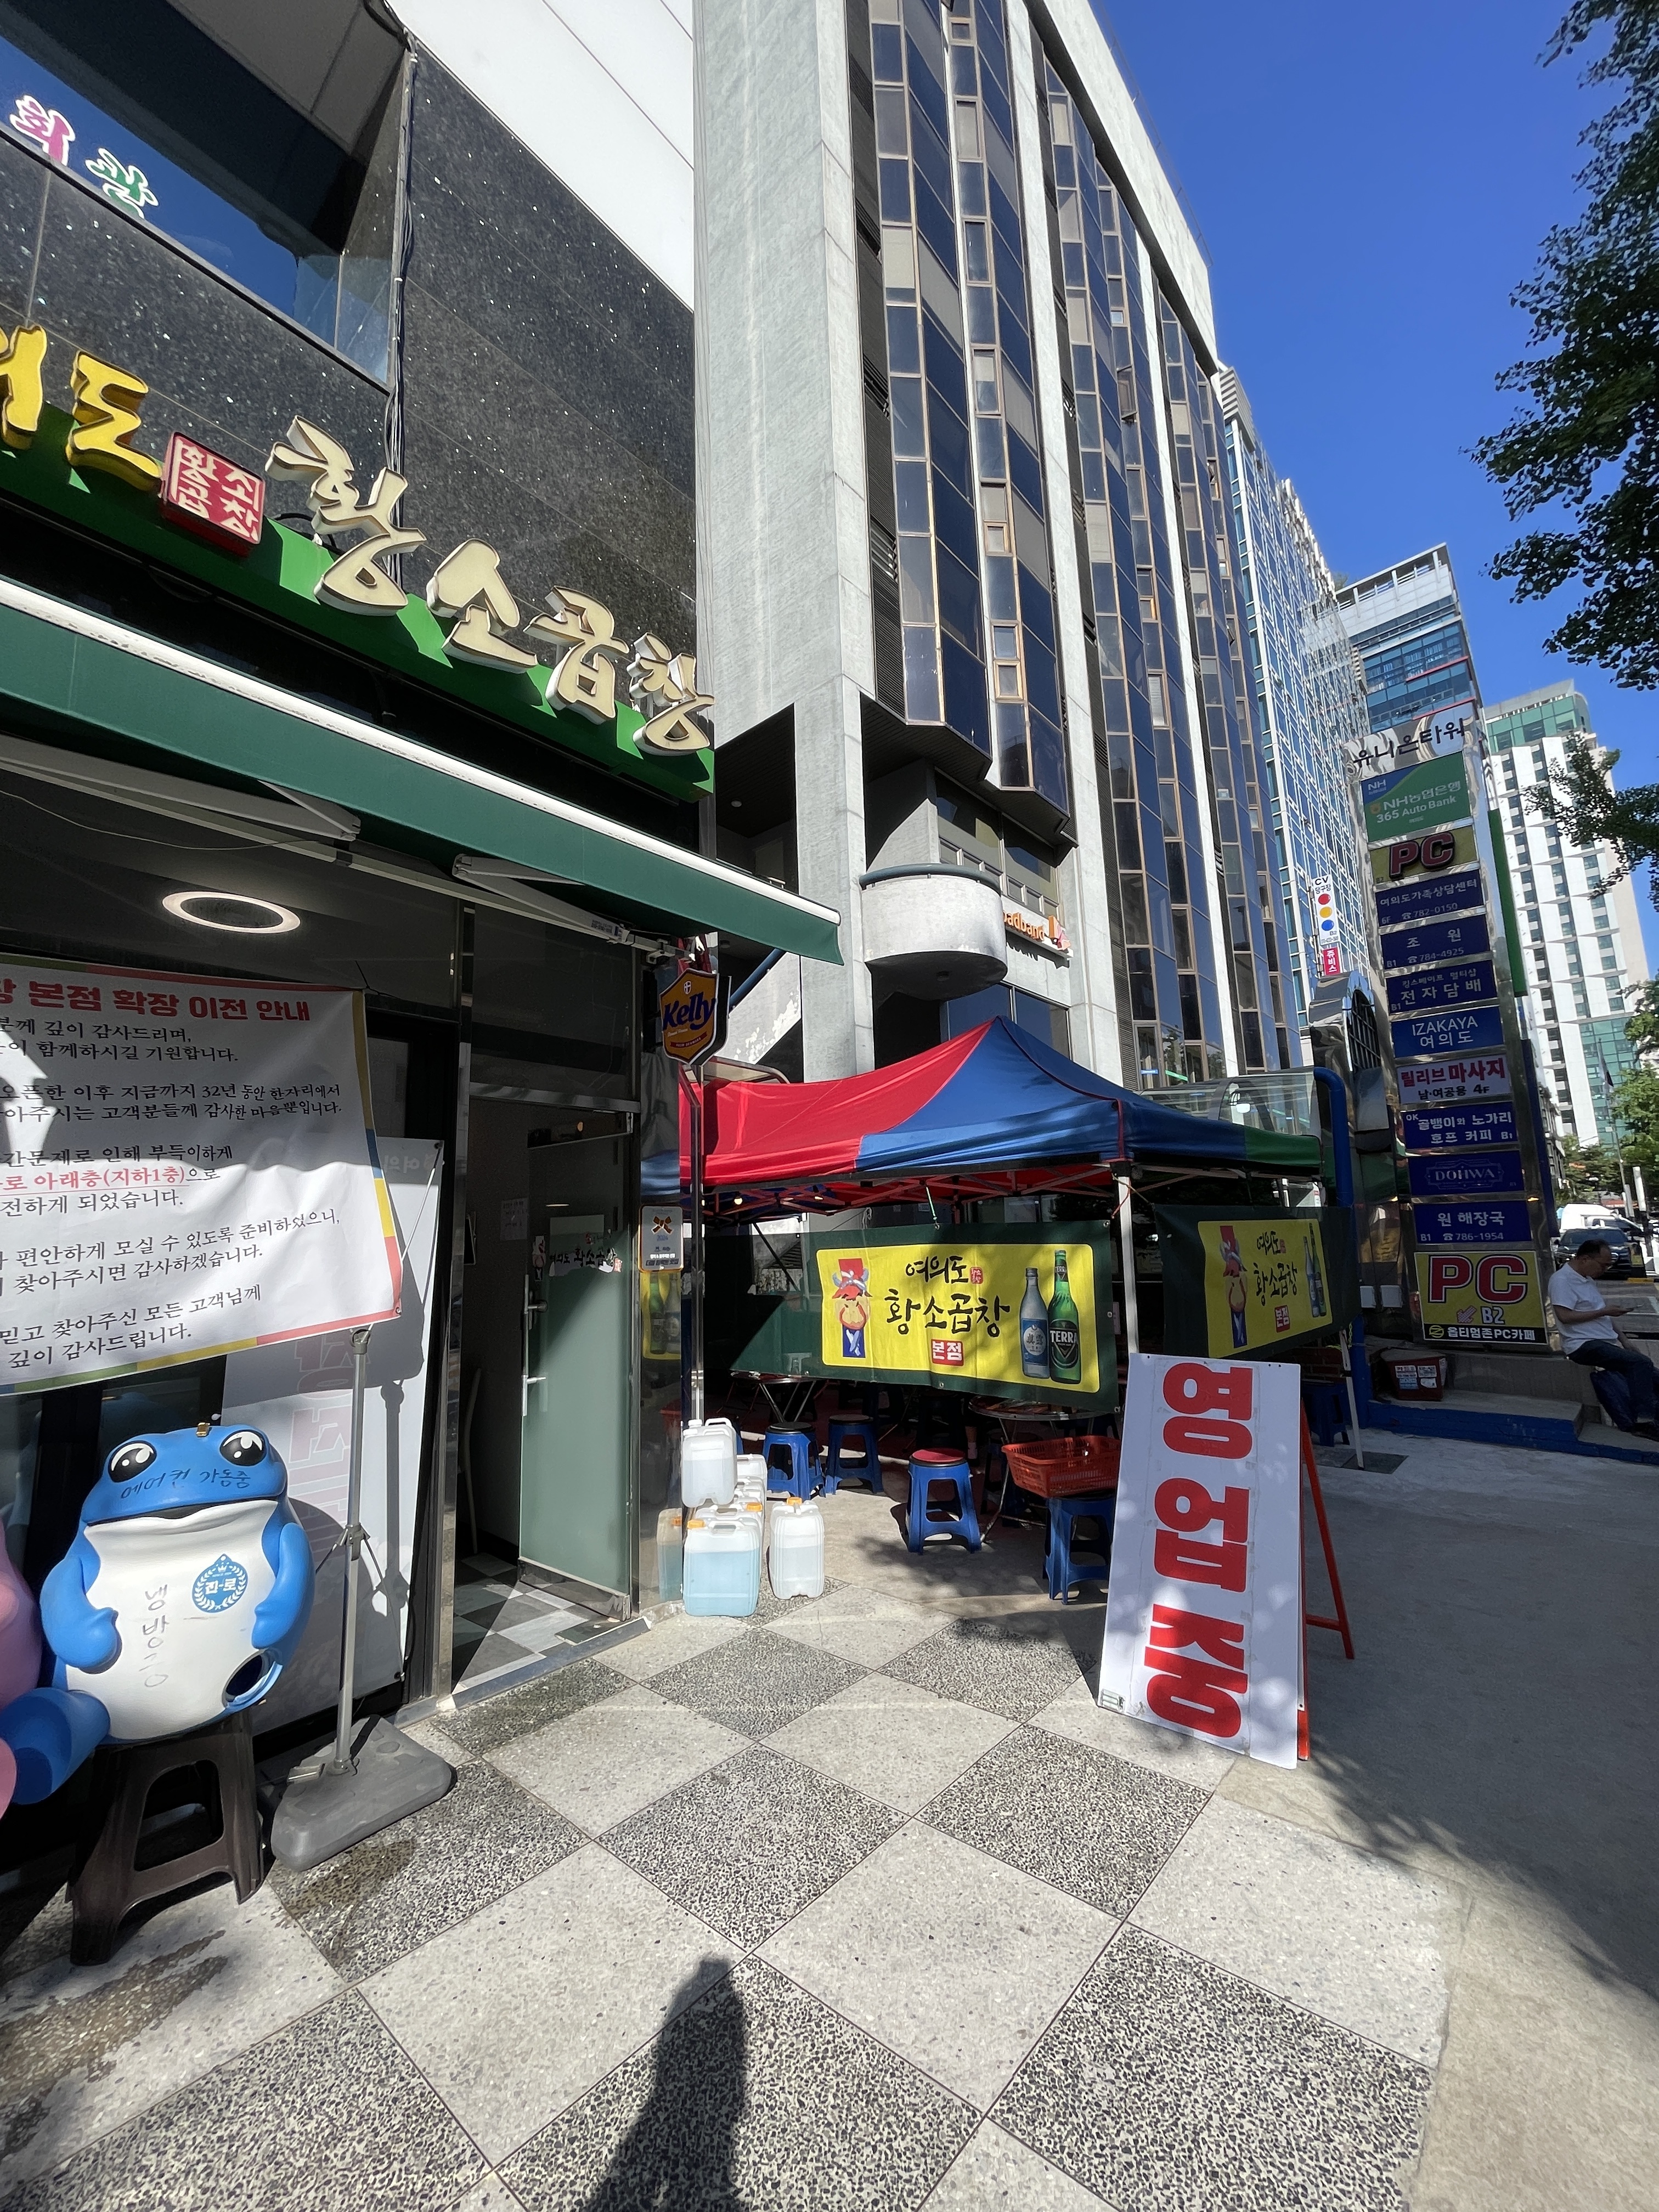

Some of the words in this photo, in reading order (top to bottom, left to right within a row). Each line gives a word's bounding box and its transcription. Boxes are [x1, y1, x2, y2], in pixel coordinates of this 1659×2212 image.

[266, 415, 715, 756] 황소곱창
[1353, 718, 1465, 768] 유니온타워
[1368, 779, 1386, 791] NH
[1376, 809, 1400, 823] 365
[1402, 803, 1427, 817] Auto
[1429, 795, 1457, 809] Bank
[1390, 831, 1455, 881] PC
[1315, 876, 1329, 885] CV
[1315, 884, 1331, 894] 당구장
[1380, 878, 1478, 906] 여의도가족상담센터
[1381, 916, 1391, 924] 6F
[1413, 902, 1458, 917] 782-0150
[1327, 950, 1338, 973] 쥬비스
[1387, 960, 1397, 968] B1
[1420, 947, 1464, 962] 784-4925
[29, 981, 102, 1012] 본점
[113, 990, 180, 1017] 확장
[189, 996, 249, 1019] 이전
[256, 1001, 311, 1021] 안내
[663, 991, 716, 1030] Kelly
[1391, 1003, 1401, 1011] B1
[44, 1020, 84, 1039] 깊이
[92, 1024, 191, 1042] 감사드리며,
[1412, 1015, 1479, 1036] IZAKAYA
[1420, 1031, 1474, 1049] 여의도
[36, 1041, 139, 1060] 함께하시길
[146, 1046, 239, 1062] 기원합니다.
[0, 1084, 66, 1101] 오픈한
[74, 1085, 114, 1101] 이후
[121, 1083, 196, 1101] 지금까지
[202, 1083, 237, 1098] 32년
[241, 1084, 266, 1101] 동안
[269, 1084, 340, 1102] 한자리에서
[1473, 1084, 1490, 1094] 4F
[0, 1104, 95, 1122] 아주시는
[101, 1103, 198, 1121] 고객분들께
[204, 1102, 247, 1120] 감사한
[250, 1100, 342, 1119] 마음뿐입니다.
[1418, 1117, 1466, 1130] 골뱅이와
[1472, 1111, 1512, 1125] 노가리
[1431, 1132, 1458, 1144] 호프
[1465, 1129, 1492, 1141] 커피
[1500, 1131, 1513, 1140] B1
[103, 1146, 141, 1163] 인해
[149, 1144, 233, 1162] 부득이하게
[0, 1175, 28, 1190] 로
[1435, 1168, 1495, 1181] DOHWA
[78, 1189, 183, 1212] 되었습니다.
[1437, 1212, 1452, 1227] 원
[1457, 1211, 1505, 1226] 해장국
[16, 1242, 105, 1268] 편안하게
[114, 1237, 154, 1255] 모실
[161, 1234, 180, 1252] 수
[186, 1226, 234, 1250] 있도록
[239, 1208, 340, 1240] 준비하였으니,
[1256, 1231, 1282, 1256] 여의도
[1456, 1232, 1504, 1241] 786-1954
[14, 1263, 127, 1295] 찾아주시면
[133, 1244, 263, 1279] 감사하겠습니다.
[906, 1255, 969, 1284] 여의도
[1428, 1254, 1528, 1305] PC
[1253, 1262, 1298, 1306] 황소곱창
[52, 1308, 138, 1339] 찾아주신
[144, 1302, 184, 1322] 모든
[189, 1284, 261, 1313] 고객님께
[884, 1288, 1011, 1338] 황소곱창
[1275, 1305, 1290, 1328] 본점
[1480, 1306, 1505, 1325] B2
[8, 1346, 53, 1369] 깊이
[62, 1323, 192, 1361] 감사드립니다.
[1049, 1330, 1079, 1344] TERRA
[932, 1340, 963, 1362] 본점
[120, 1468, 191, 1499] 에어컨
[199, 1468, 251, 1488] 가동중
